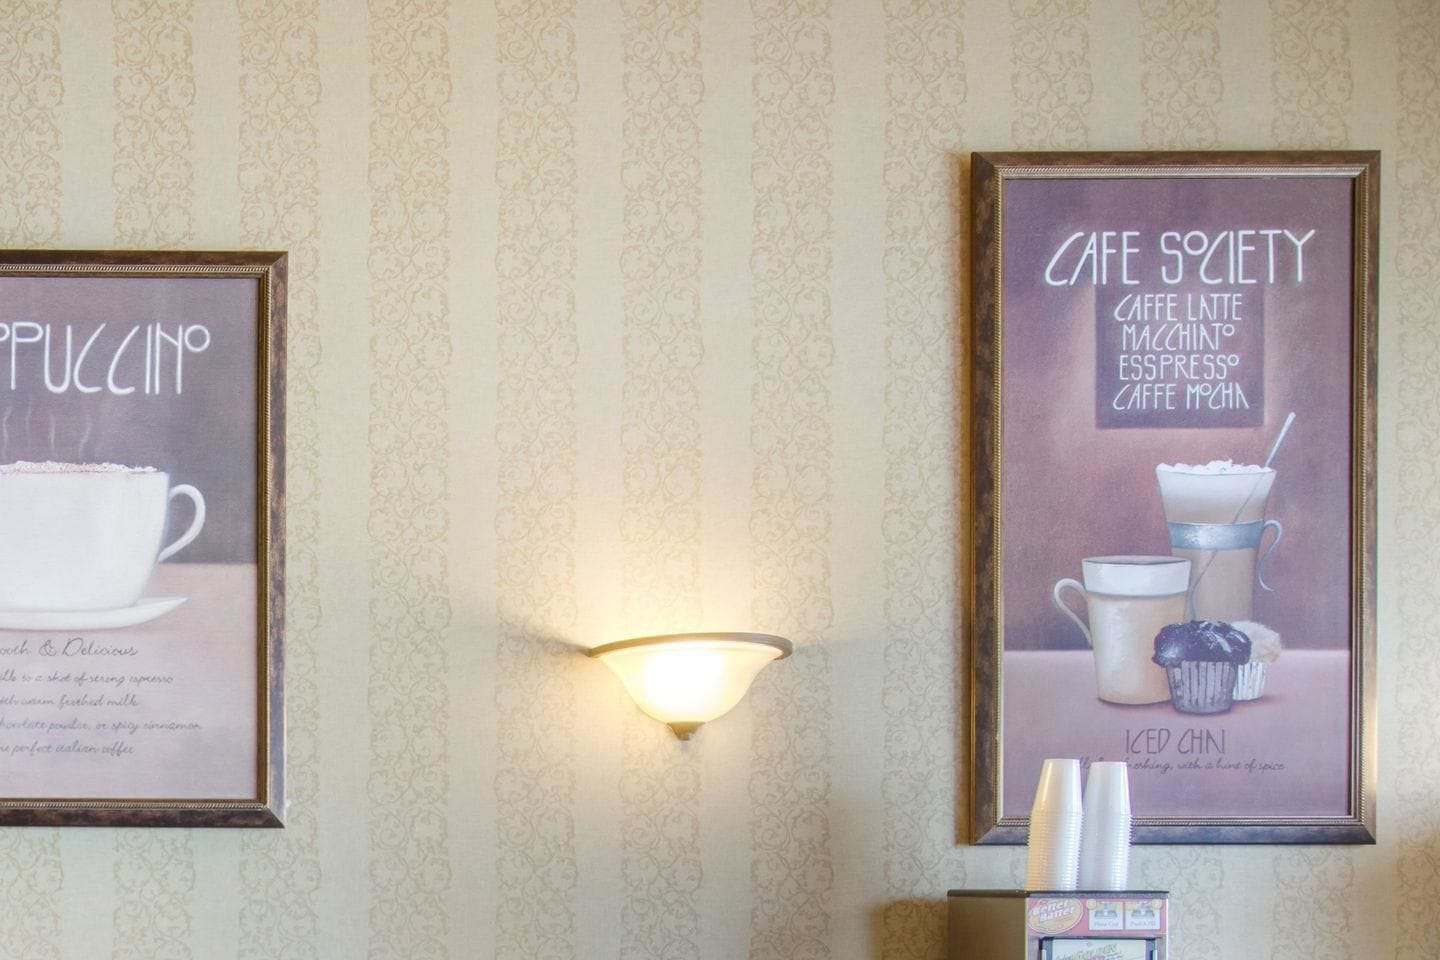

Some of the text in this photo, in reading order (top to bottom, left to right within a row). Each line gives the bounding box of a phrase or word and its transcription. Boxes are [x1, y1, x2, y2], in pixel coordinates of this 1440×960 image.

[1044, 229, 1315, 286] CAFE SOCIETY
[1114, 293, 1242, 321] CAFFE LATTE
[1122, 323, 1235, 351] MACCHIATO
[1119, 354, 1240, 381] ESSPRESSO
[1112, 382, 1250, 410] CAFFE MOCHA
[39, 639, 57, 656] &
[62, 637, 138, 656] Delicious
[90, 673, 124, 688] strong
[106, 693, 138, 706] milk
[10, 740, 53, 756] perfect
[1126, 728, 1225, 754] ICED CHAI
[1244, 758, 1257, 773] of
